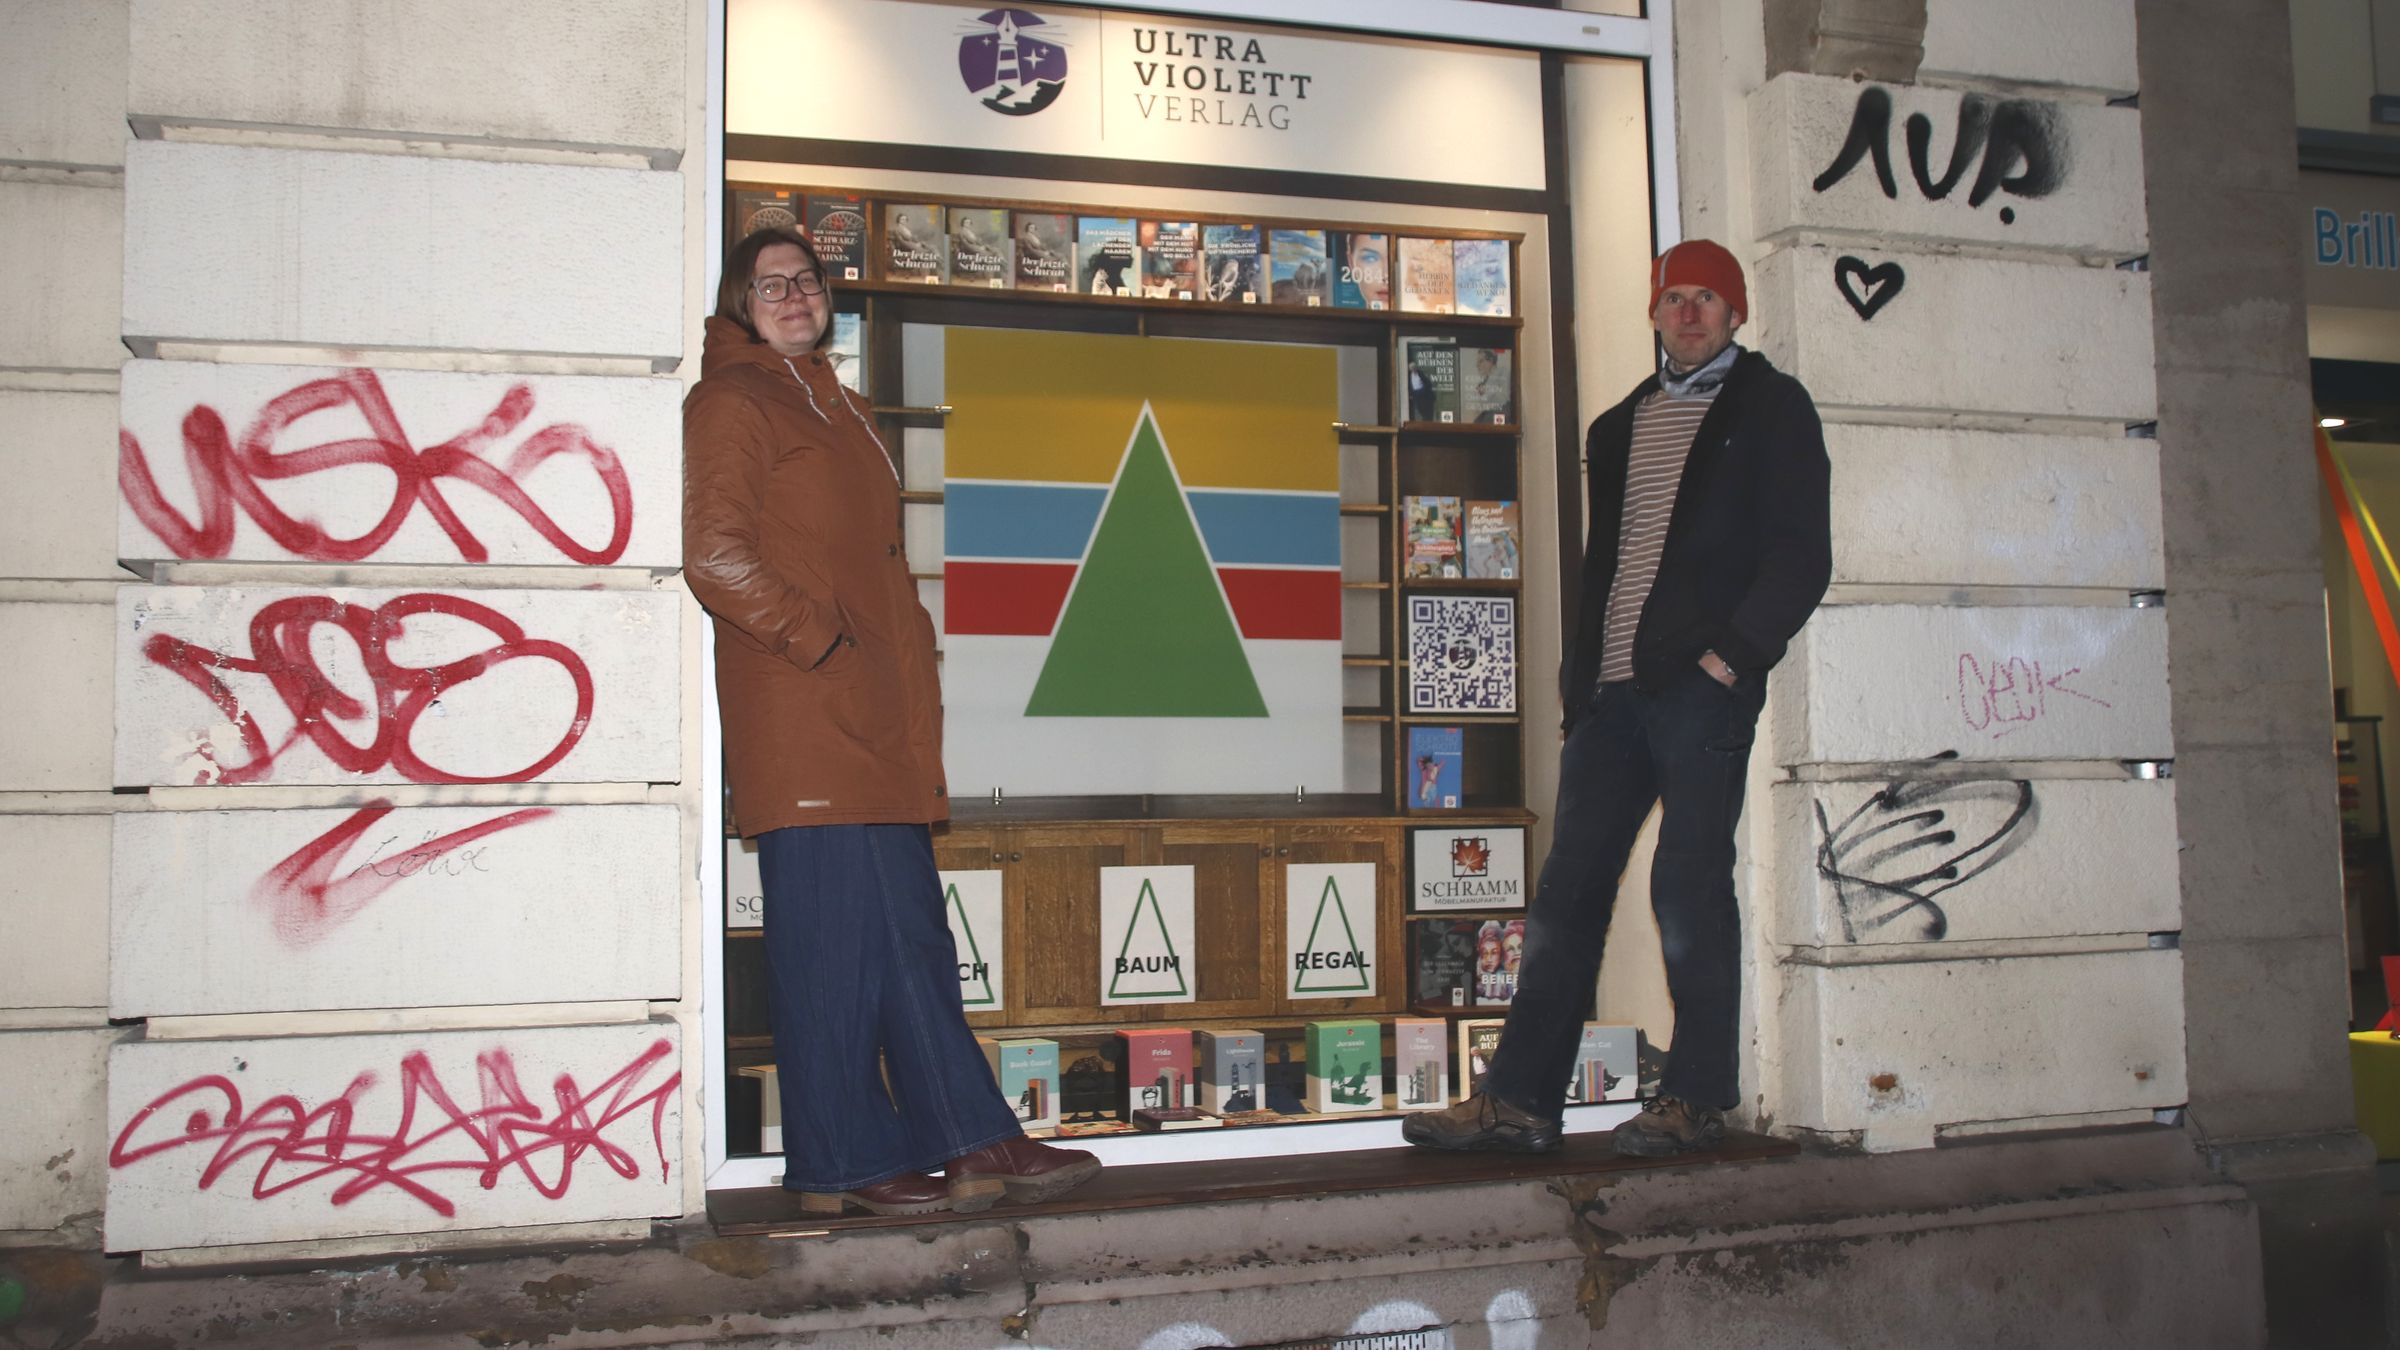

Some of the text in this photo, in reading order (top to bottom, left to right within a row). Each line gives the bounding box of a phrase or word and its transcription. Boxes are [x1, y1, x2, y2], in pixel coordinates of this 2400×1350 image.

[1133, 28, 1266, 63] ULTRA
[1133, 61, 1312, 99] VIOLETT
[1134, 93, 1290, 130] VERLAG
[2313, 207, 2400, 271] Brill
[1417, 351, 1454, 359] AUF DEN
[1430, 374, 1454, 382] WELT
[1422, 880, 1518, 898] SCHRAMM
[1434, 897, 1507, 905] MÖBELMANUFAKTUR
[1115, 956, 1180, 974] BAUM
[1295, 951, 1370, 970] REGAL
[958, 963, 988, 981] CH
[1481, 974, 1518, 984] BENEF
[1152, 1049, 1172, 1057] Frida
